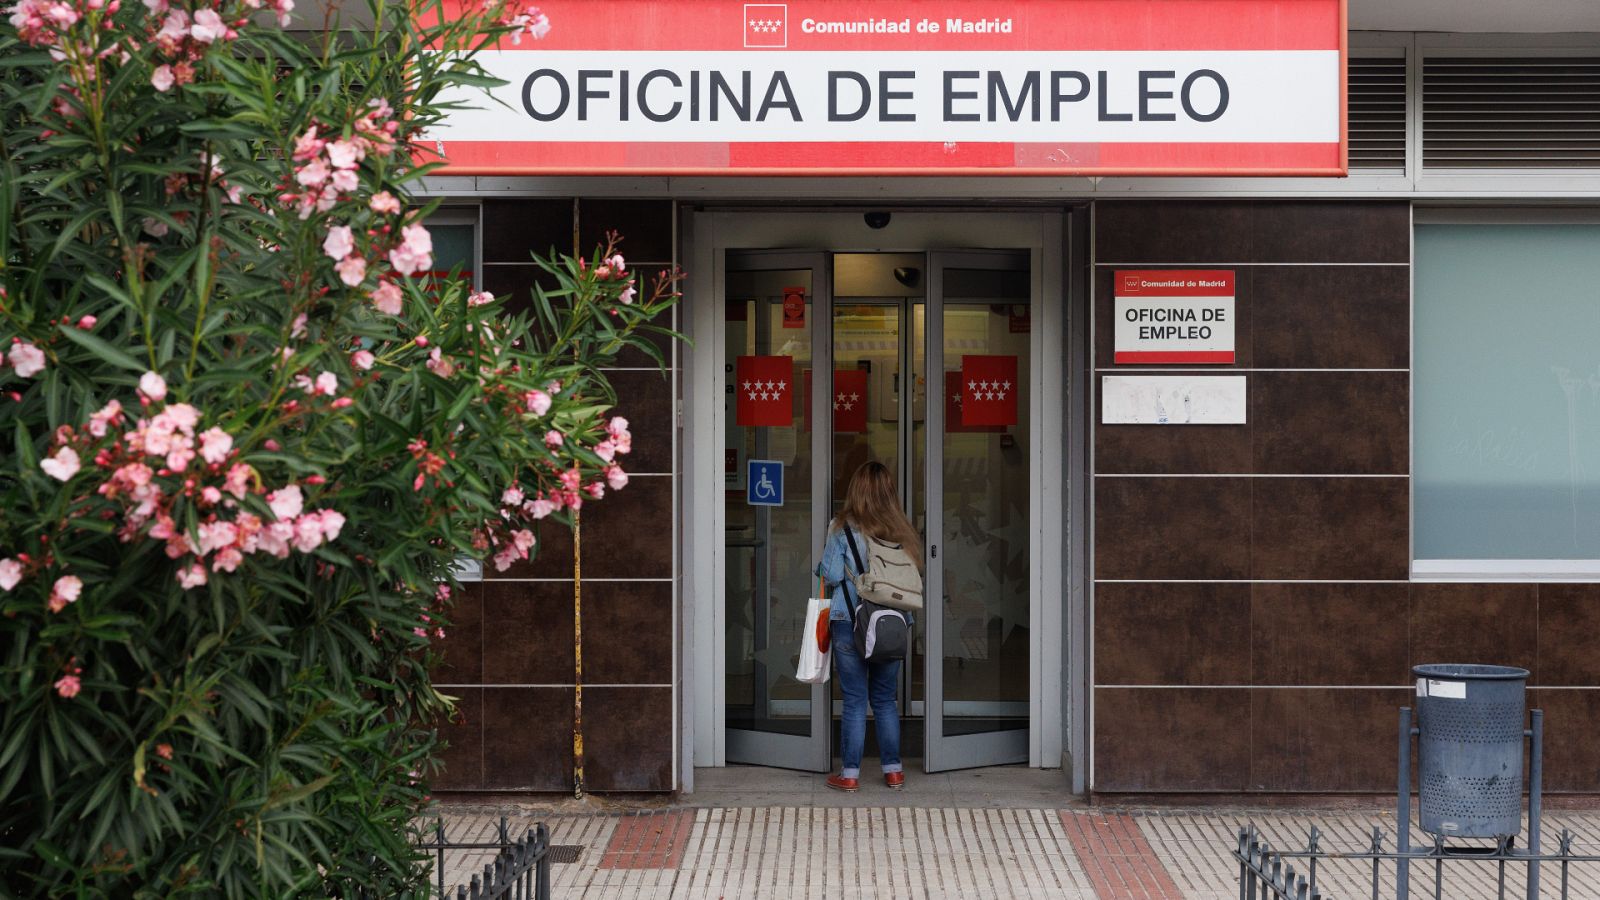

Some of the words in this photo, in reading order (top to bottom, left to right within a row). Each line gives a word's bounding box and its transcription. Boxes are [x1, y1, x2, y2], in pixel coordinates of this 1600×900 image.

[801, 18, 911, 34] Comunidad
[917, 18, 940, 34] de
[946, 18, 1013, 34] Madrid
[521, 68, 804, 123] OFICINA
[827, 70, 917, 122] DE
[942, 68, 1230, 123] EMPLEO
[1141, 280, 1185, 288] Comunidad
[1186, 280, 1197, 288] de
[1198, 280, 1226, 288] Madrid
[1125, 308, 1197, 322] OFICINA
[1201, 308, 1225, 322] DE
[1138, 325, 1212, 340] EMPLEO
